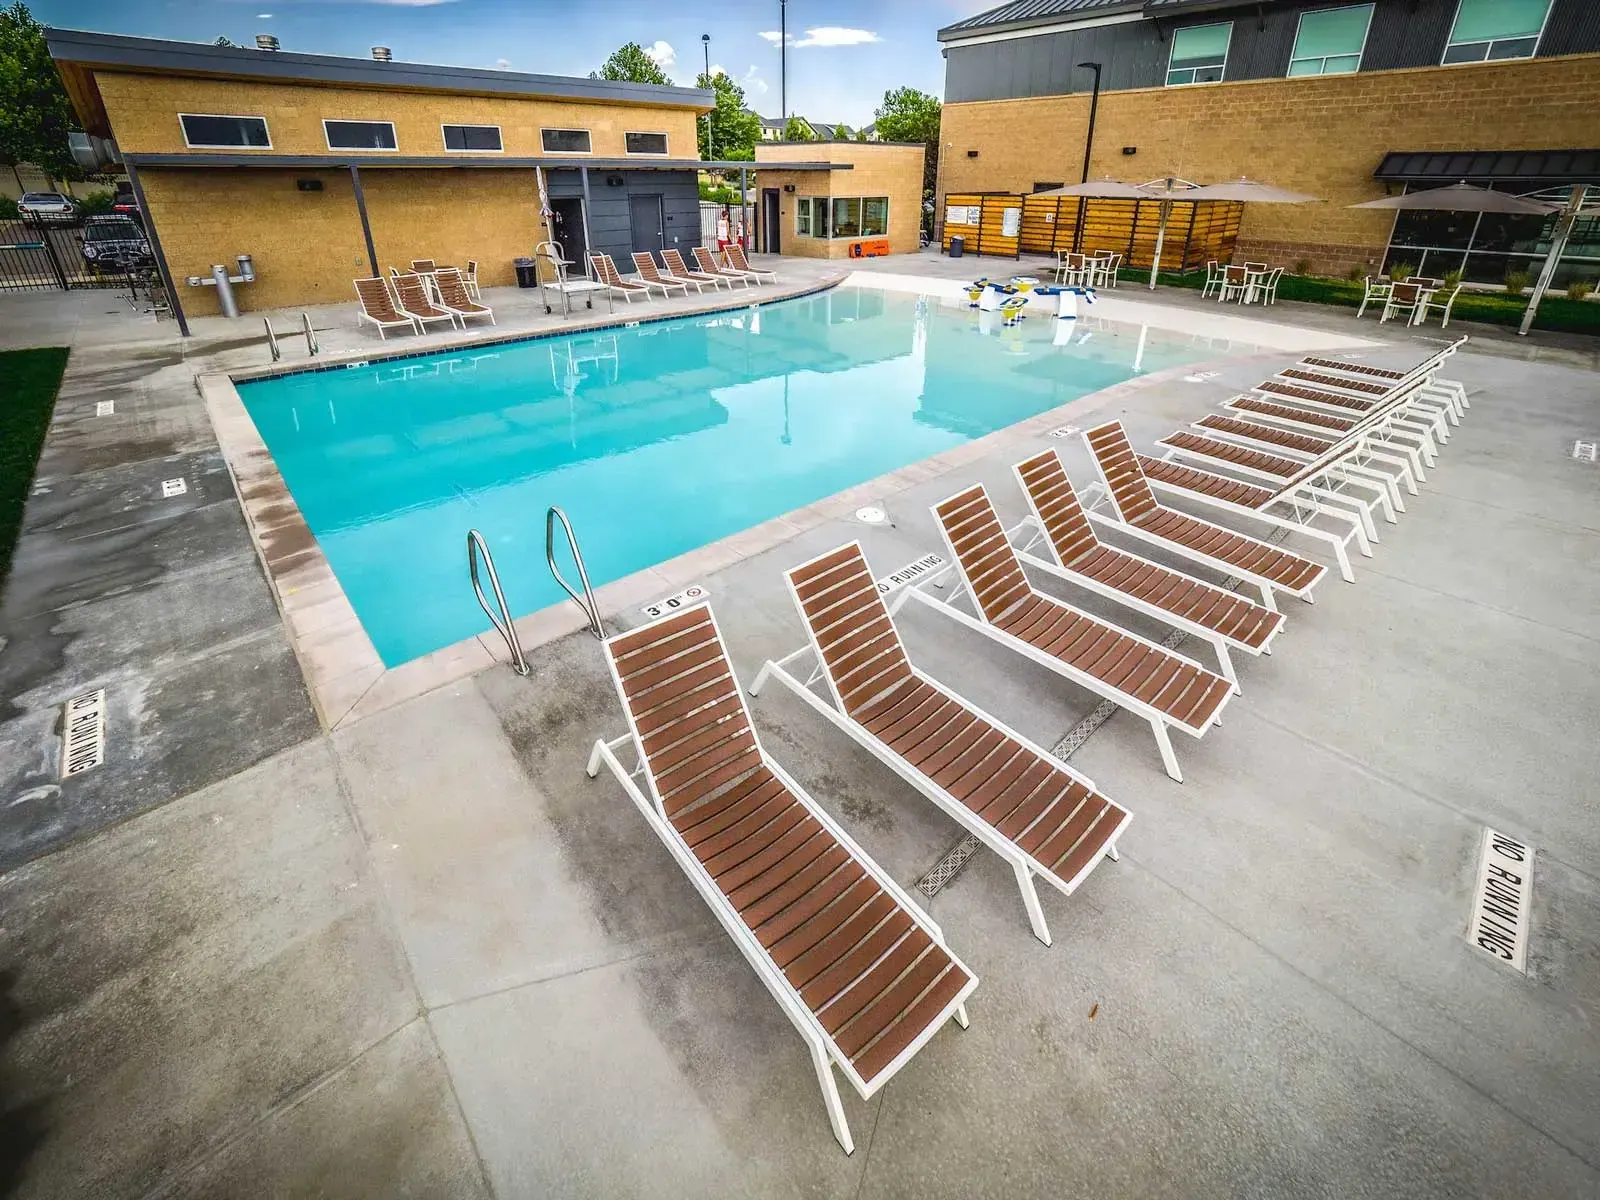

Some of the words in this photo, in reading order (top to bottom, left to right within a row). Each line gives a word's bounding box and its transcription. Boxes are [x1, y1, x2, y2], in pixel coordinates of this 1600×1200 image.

[877, 583, 890, 594] O
[890, 555, 942, 584] RUNNING
[73, 692, 98, 710] NO
[68, 711, 99, 773] RUNNING
[1492, 833, 1526, 862] NO
[1477, 863, 1522, 961] RUNNING
